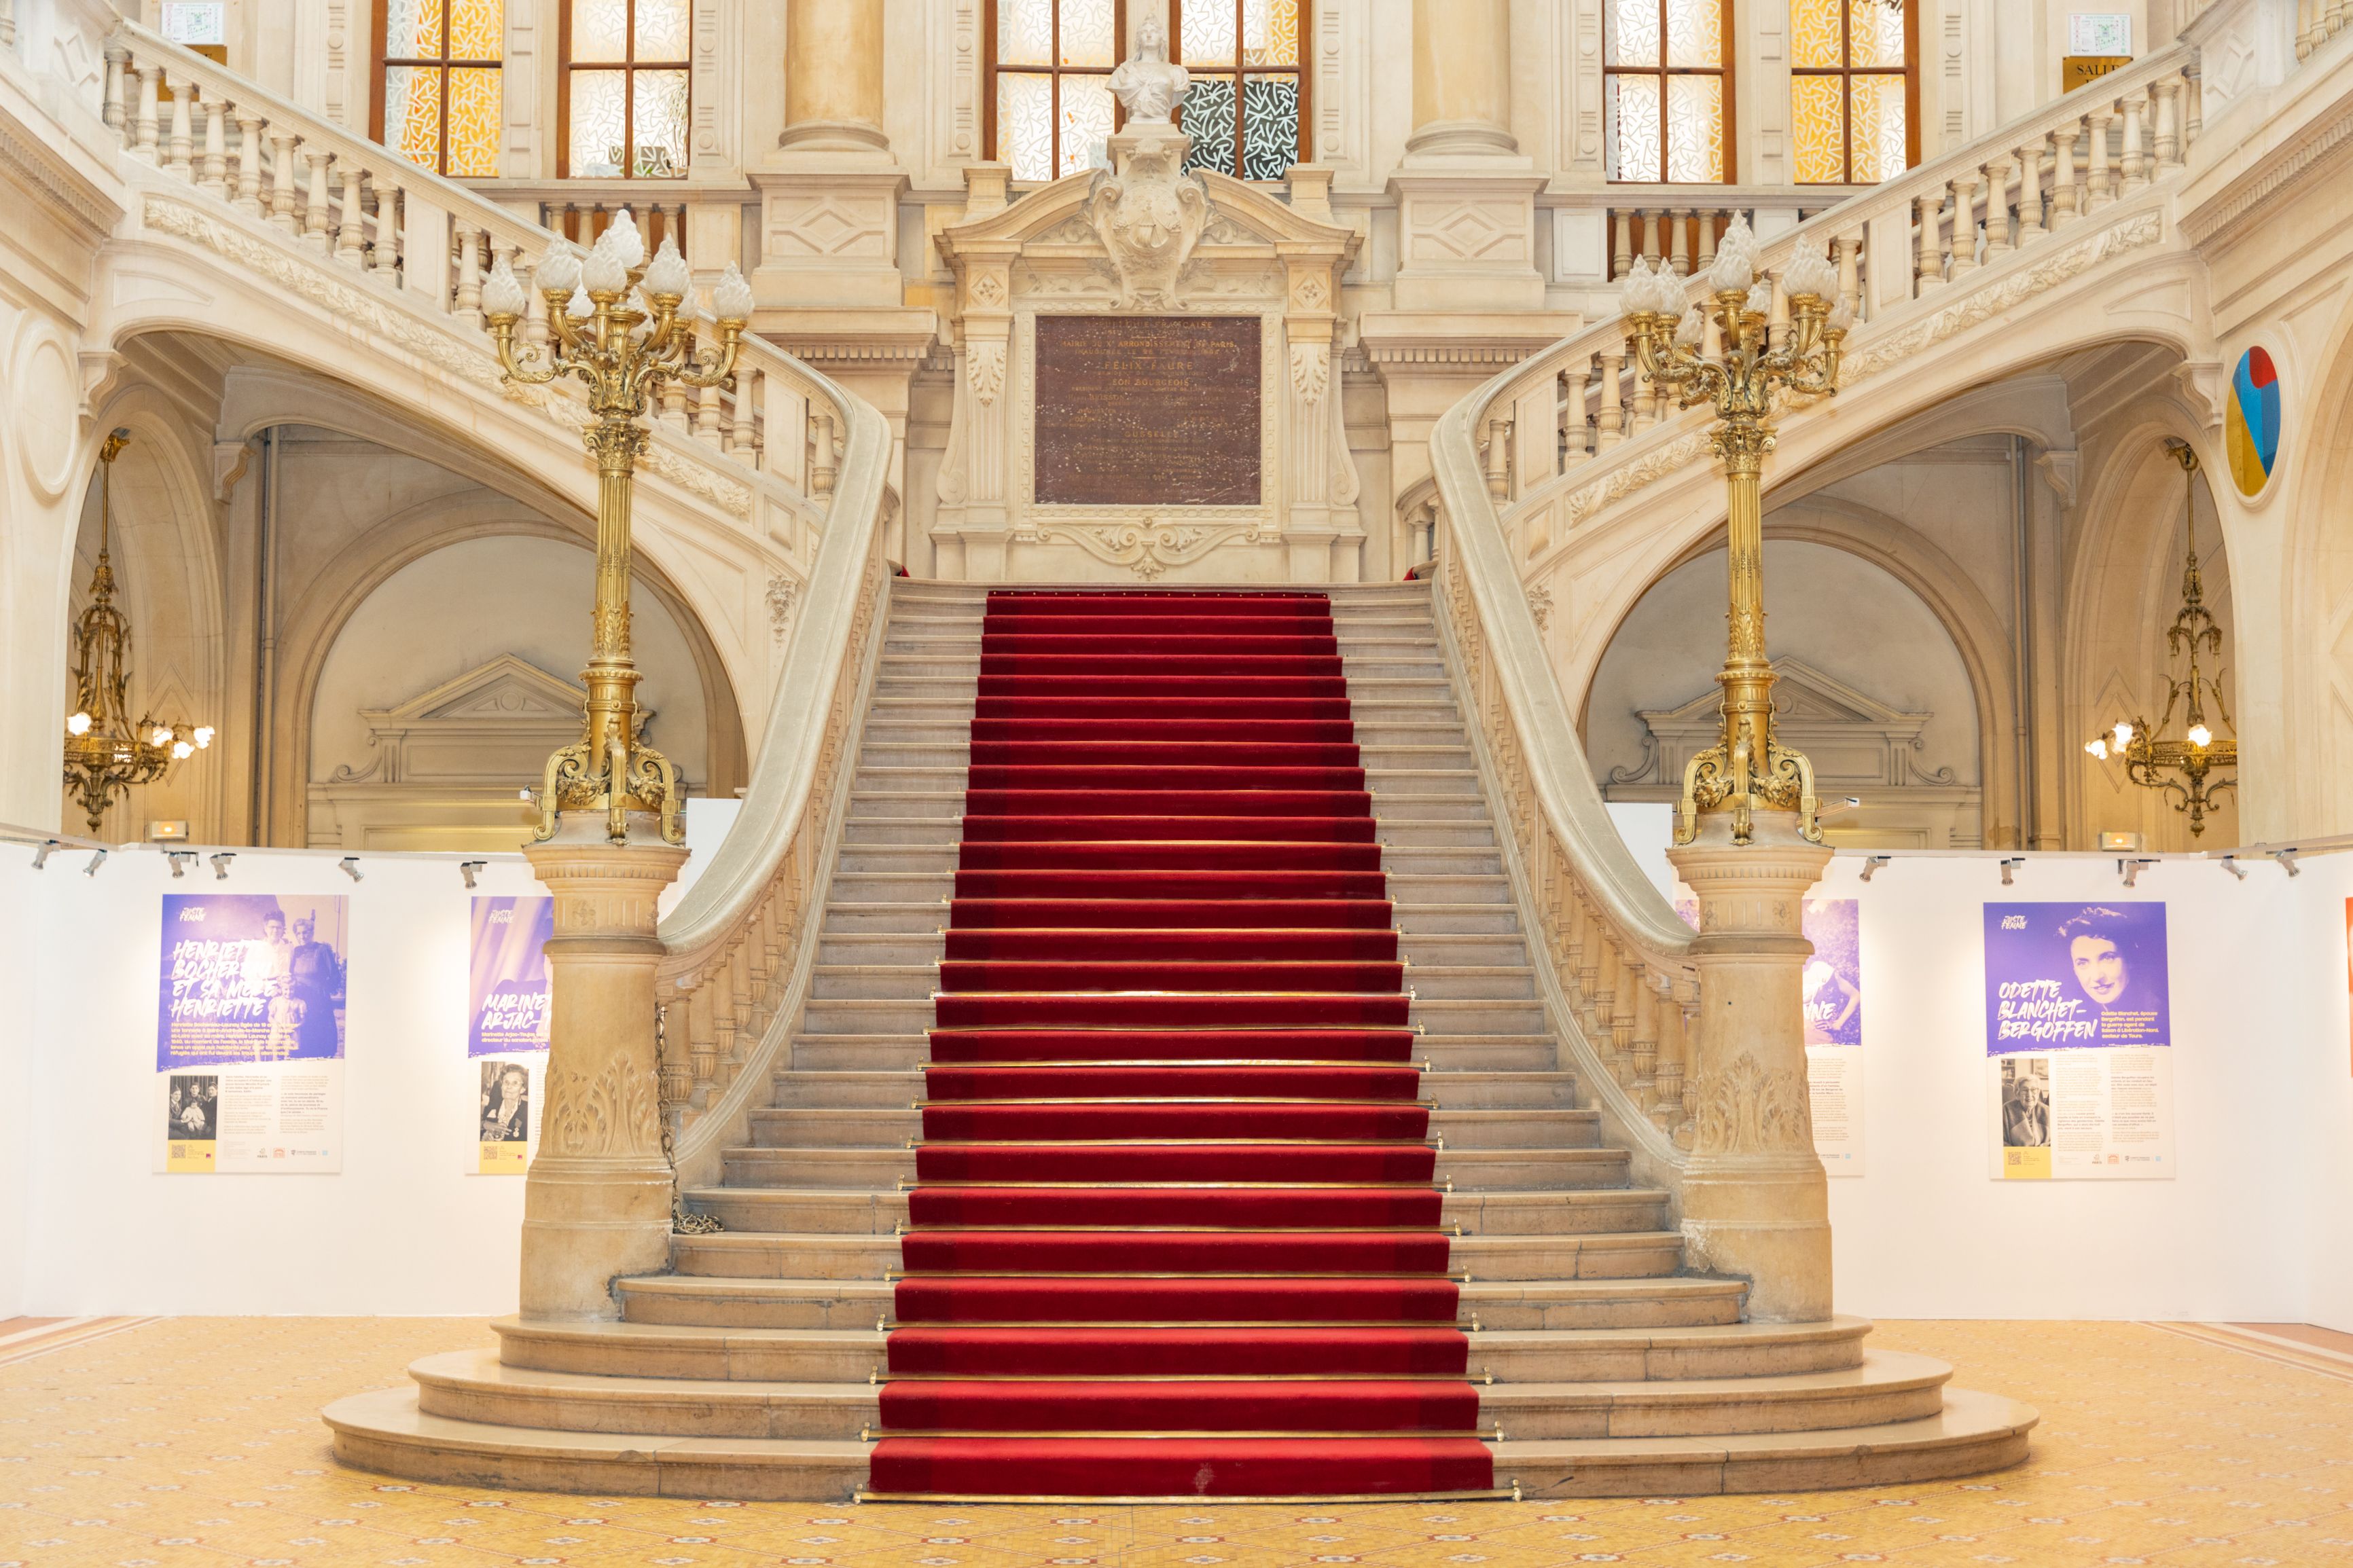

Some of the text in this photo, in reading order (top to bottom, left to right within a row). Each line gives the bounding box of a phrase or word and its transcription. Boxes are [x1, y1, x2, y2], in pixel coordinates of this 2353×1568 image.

[173, 978, 201, 998] ET
[1998, 979, 2062, 1001] ODETTE
[171, 996, 266, 1022] HENRIETTE
[1996, 996, 2087, 1023] BLANCHET-
[1997, 1019, 2098, 1042] BERGOFFEN
